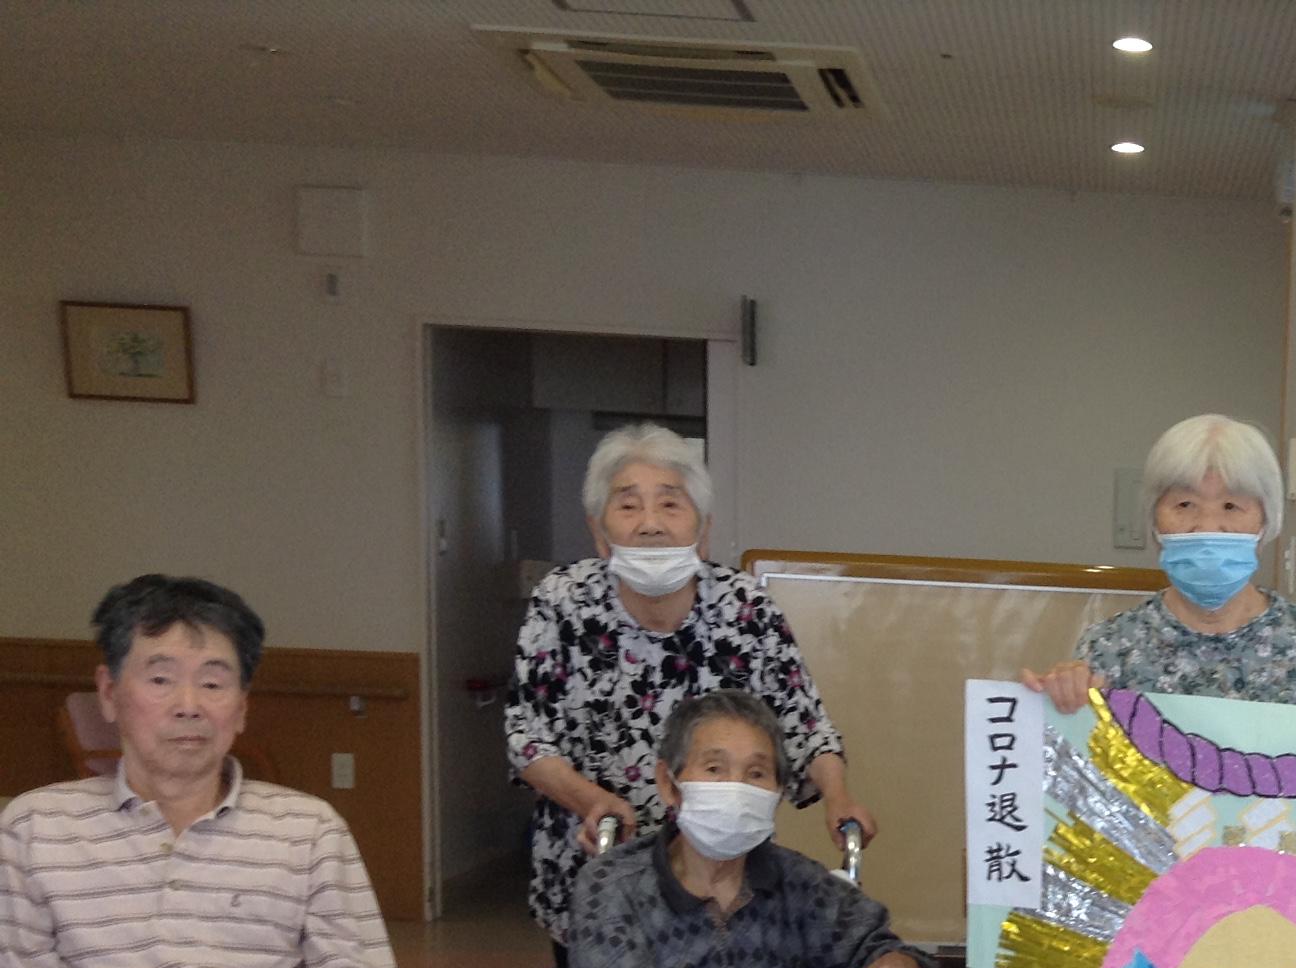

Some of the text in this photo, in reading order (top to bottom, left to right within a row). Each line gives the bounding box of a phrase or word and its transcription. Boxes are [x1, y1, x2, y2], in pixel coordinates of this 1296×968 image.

[983, 695, 1030, 883] コロナ退散
